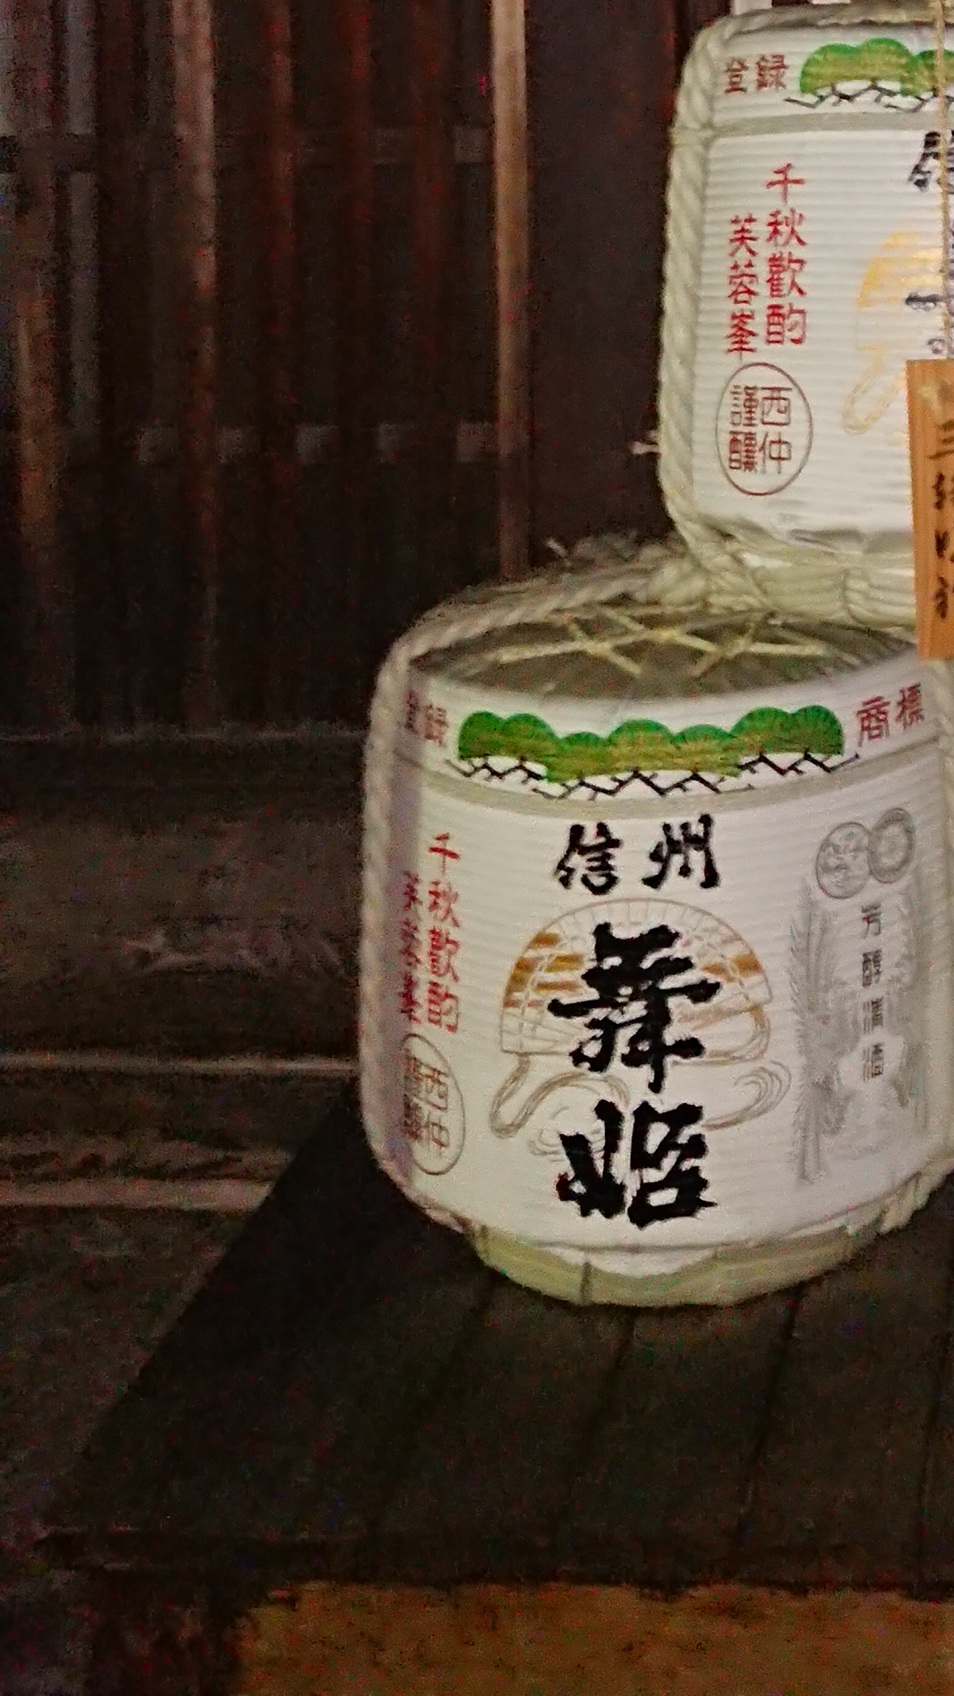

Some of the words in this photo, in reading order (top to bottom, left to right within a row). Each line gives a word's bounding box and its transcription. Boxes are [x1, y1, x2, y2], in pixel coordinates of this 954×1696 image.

[724, 55, 789, 95] 登録
[857, 683, 924, 747] 商標
[556, 814, 721, 895] 信州
